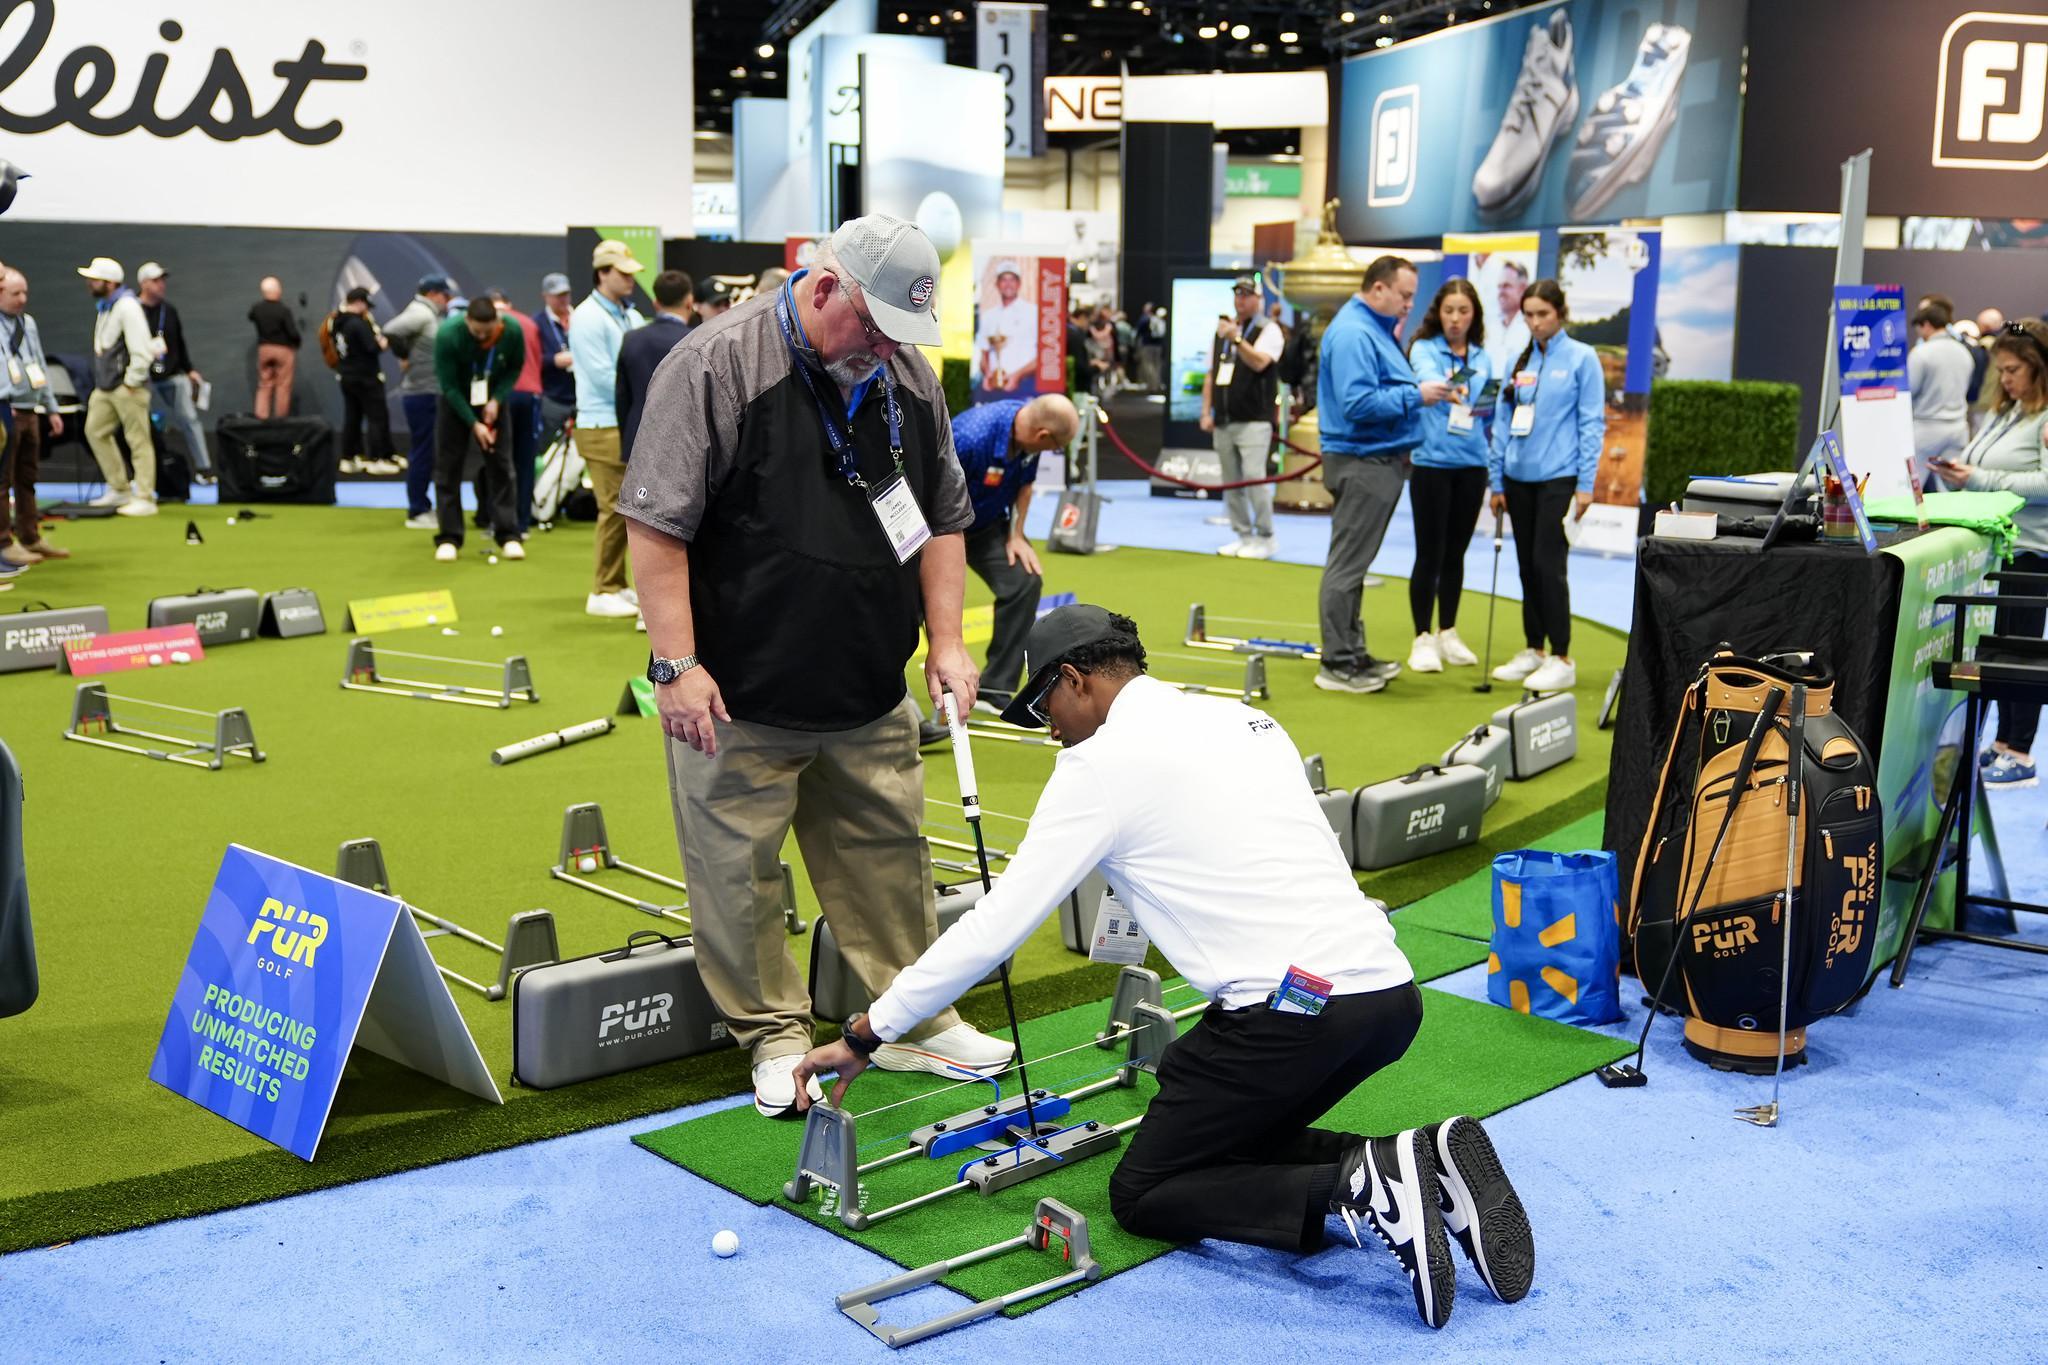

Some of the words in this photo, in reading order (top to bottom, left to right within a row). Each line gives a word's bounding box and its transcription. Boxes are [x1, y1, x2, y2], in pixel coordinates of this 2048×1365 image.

[1957, 40, 2048, 143] FJ
[1376, 106, 1411, 187] FJ
[1040, 267, 1061, 381] BRADLEY
[1843, 325, 1871, 350] PUR
[1926, 562, 1946, 592] PUR
[5, 627, 49, 651] PUR
[49, 623, 86, 635] TRUTH
[195, 611, 228, 630] PUR
[71, 649, 107, 662] PUTTING
[107, 643, 142, 657] CONTEST
[1530, 721, 1551, 751] PUR
[1406, 803, 1446, 835] PUR
[1834, 856, 1868, 955] PUR
[247, 896, 329, 968] PUR
[1691, 915, 1760, 953] PUR
[257, 957, 294, 979] GOLF
[1713, 946, 1747, 959] GOLF
[203, 983, 317, 1051] PRODUCING
[598, 992, 674, 1038] PUR
[191, 1009, 310, 1081] UNMATCHED
[598, 1025, 672, 1048] WWW.PUR.GOLF
[198, 1044, 282, 1103] RESULTS
